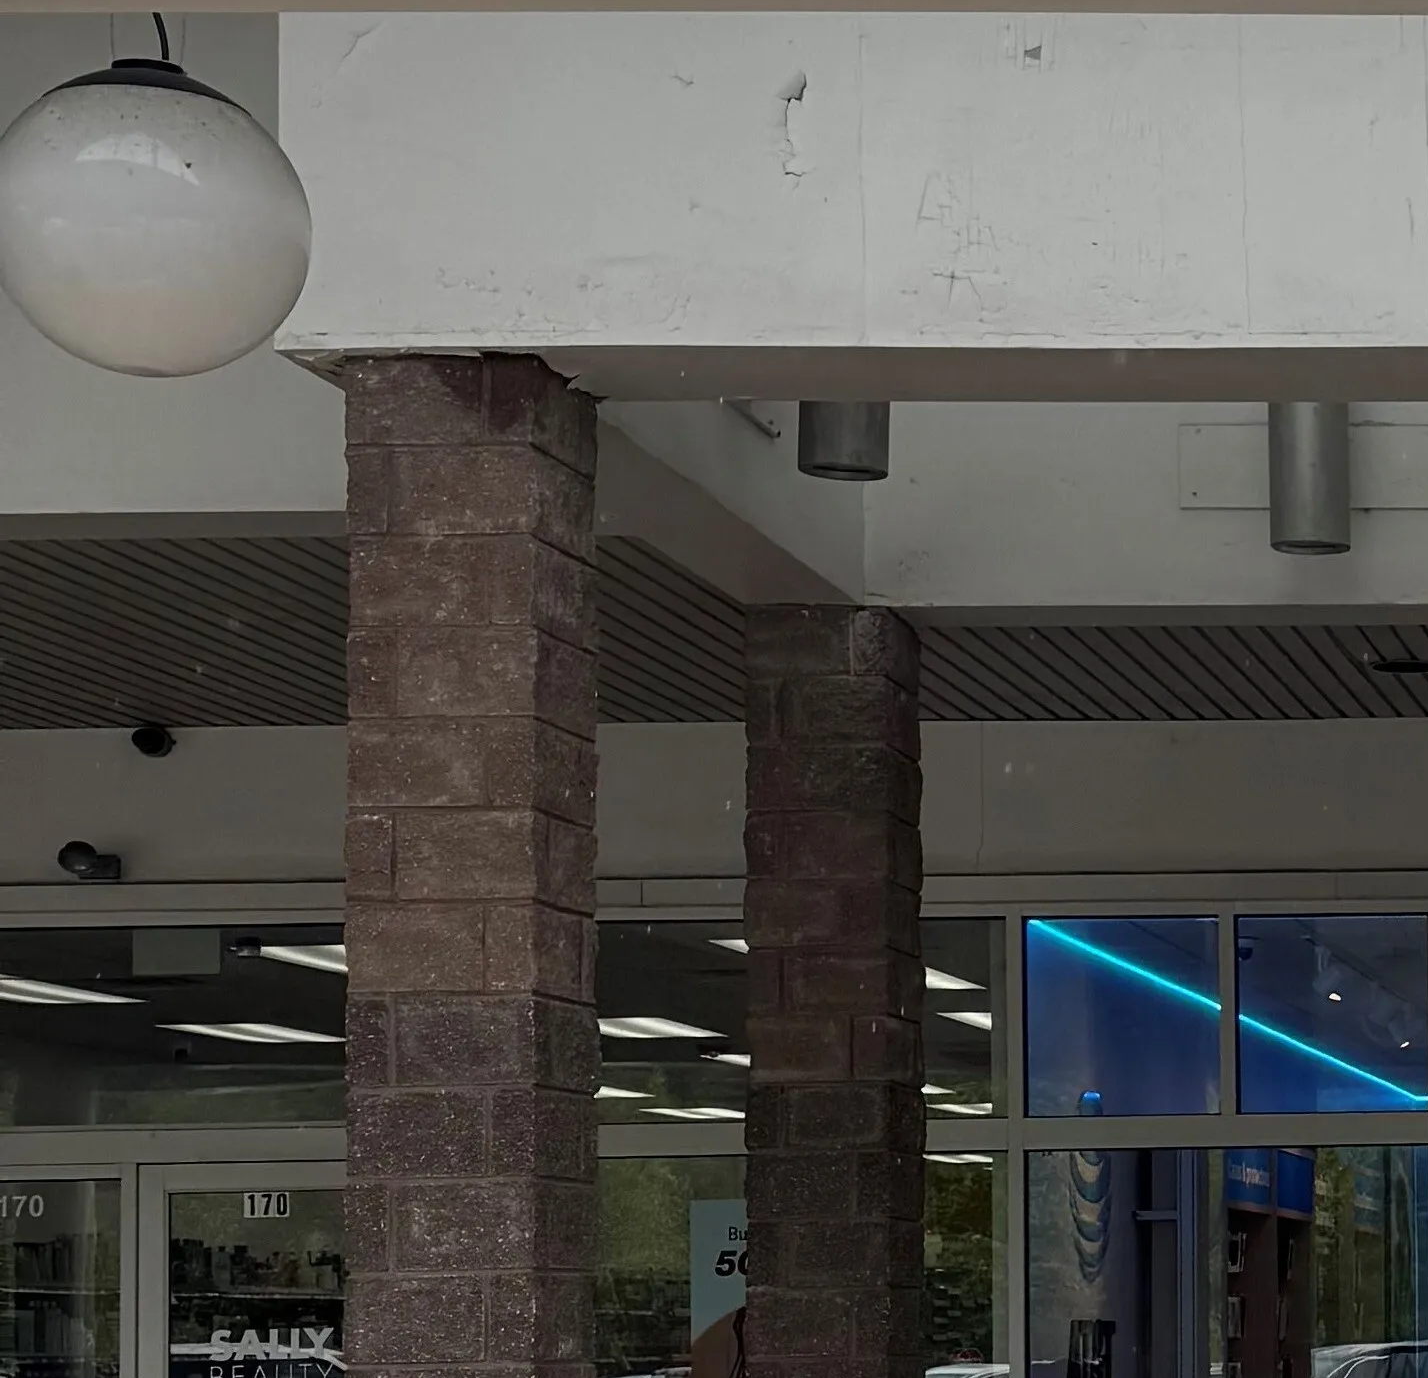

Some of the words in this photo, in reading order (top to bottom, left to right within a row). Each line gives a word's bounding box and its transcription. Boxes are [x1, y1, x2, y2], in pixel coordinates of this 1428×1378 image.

[0, 1194, 44, 1218] 170
[247, 1193, 288, 1217] 170
[209, 1327, 334, 1362] SALLY
